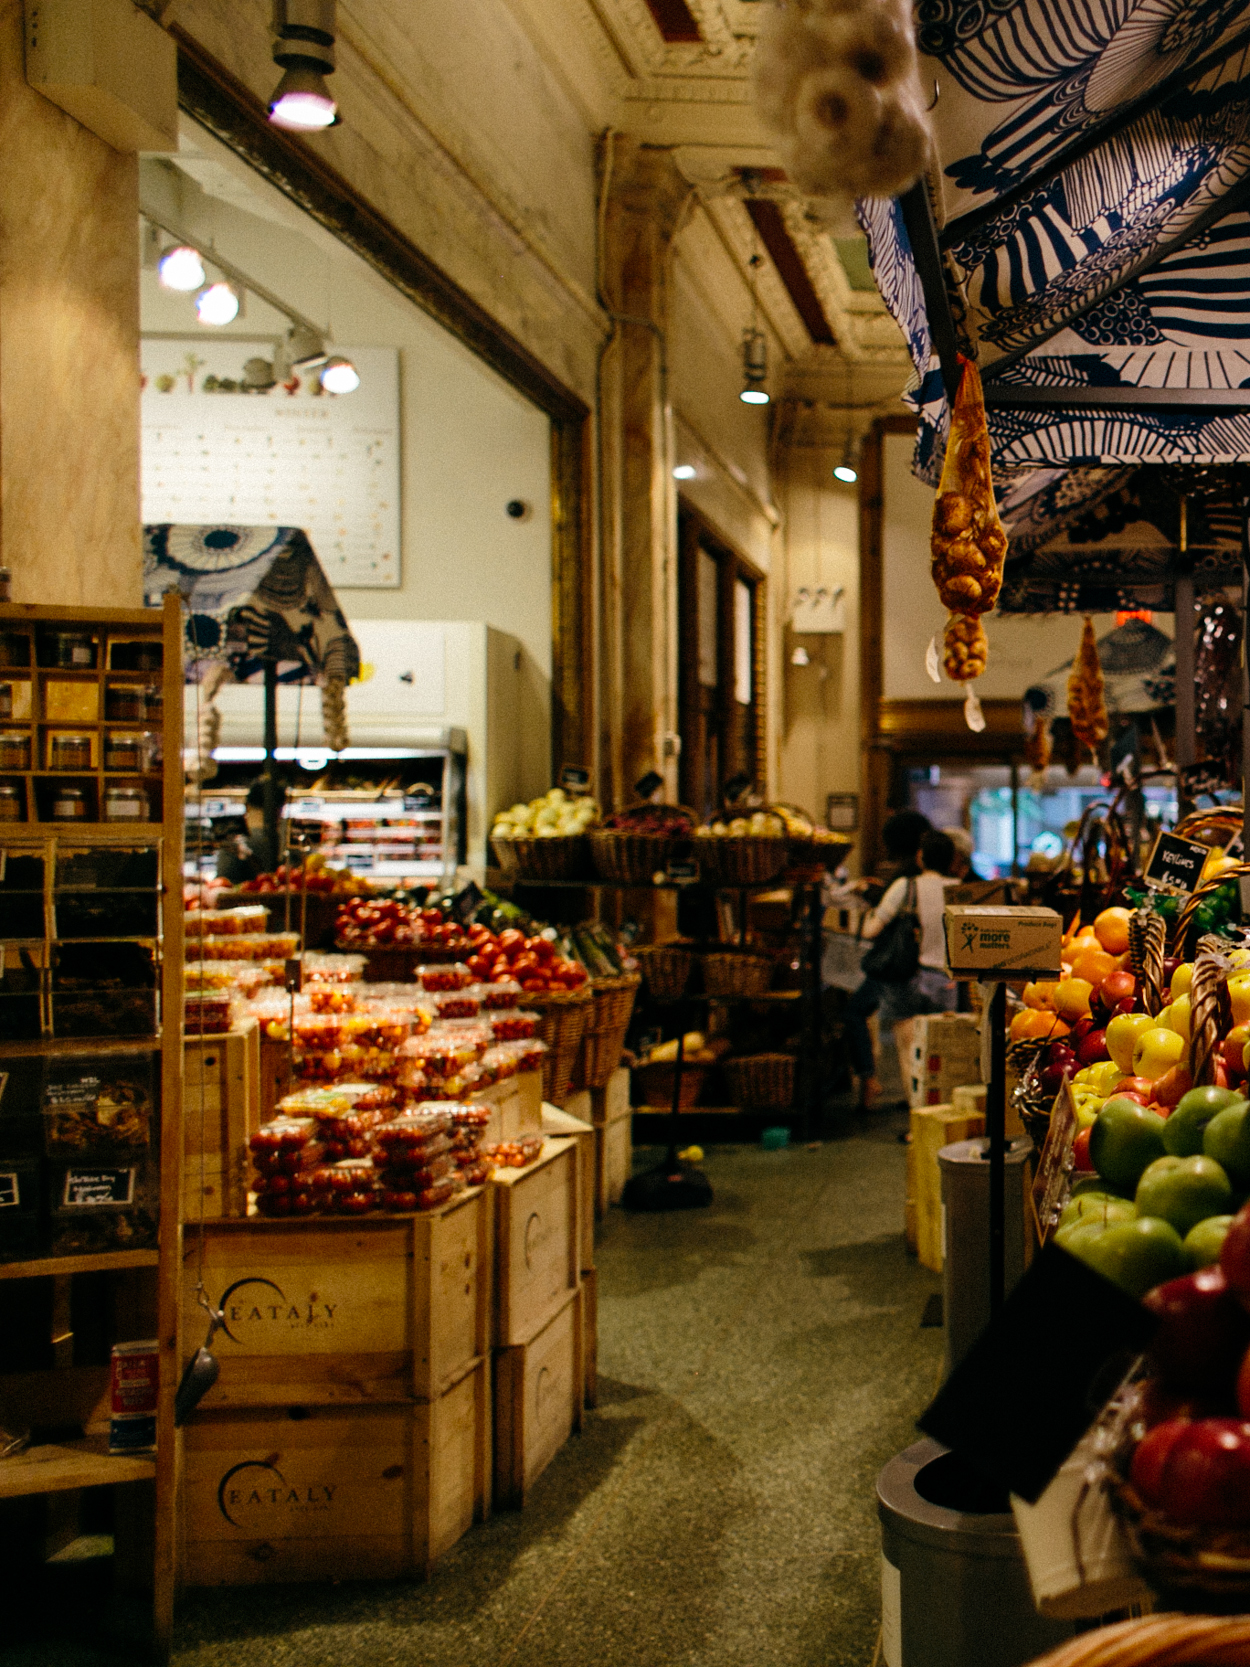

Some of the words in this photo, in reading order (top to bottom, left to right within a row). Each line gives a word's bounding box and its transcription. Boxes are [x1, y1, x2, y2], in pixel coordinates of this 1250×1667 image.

[980, 932, 1011, 942] more
[230, 1303, 337, 1321] EATALY
[229, 1485, 337, 1505] EATALY
